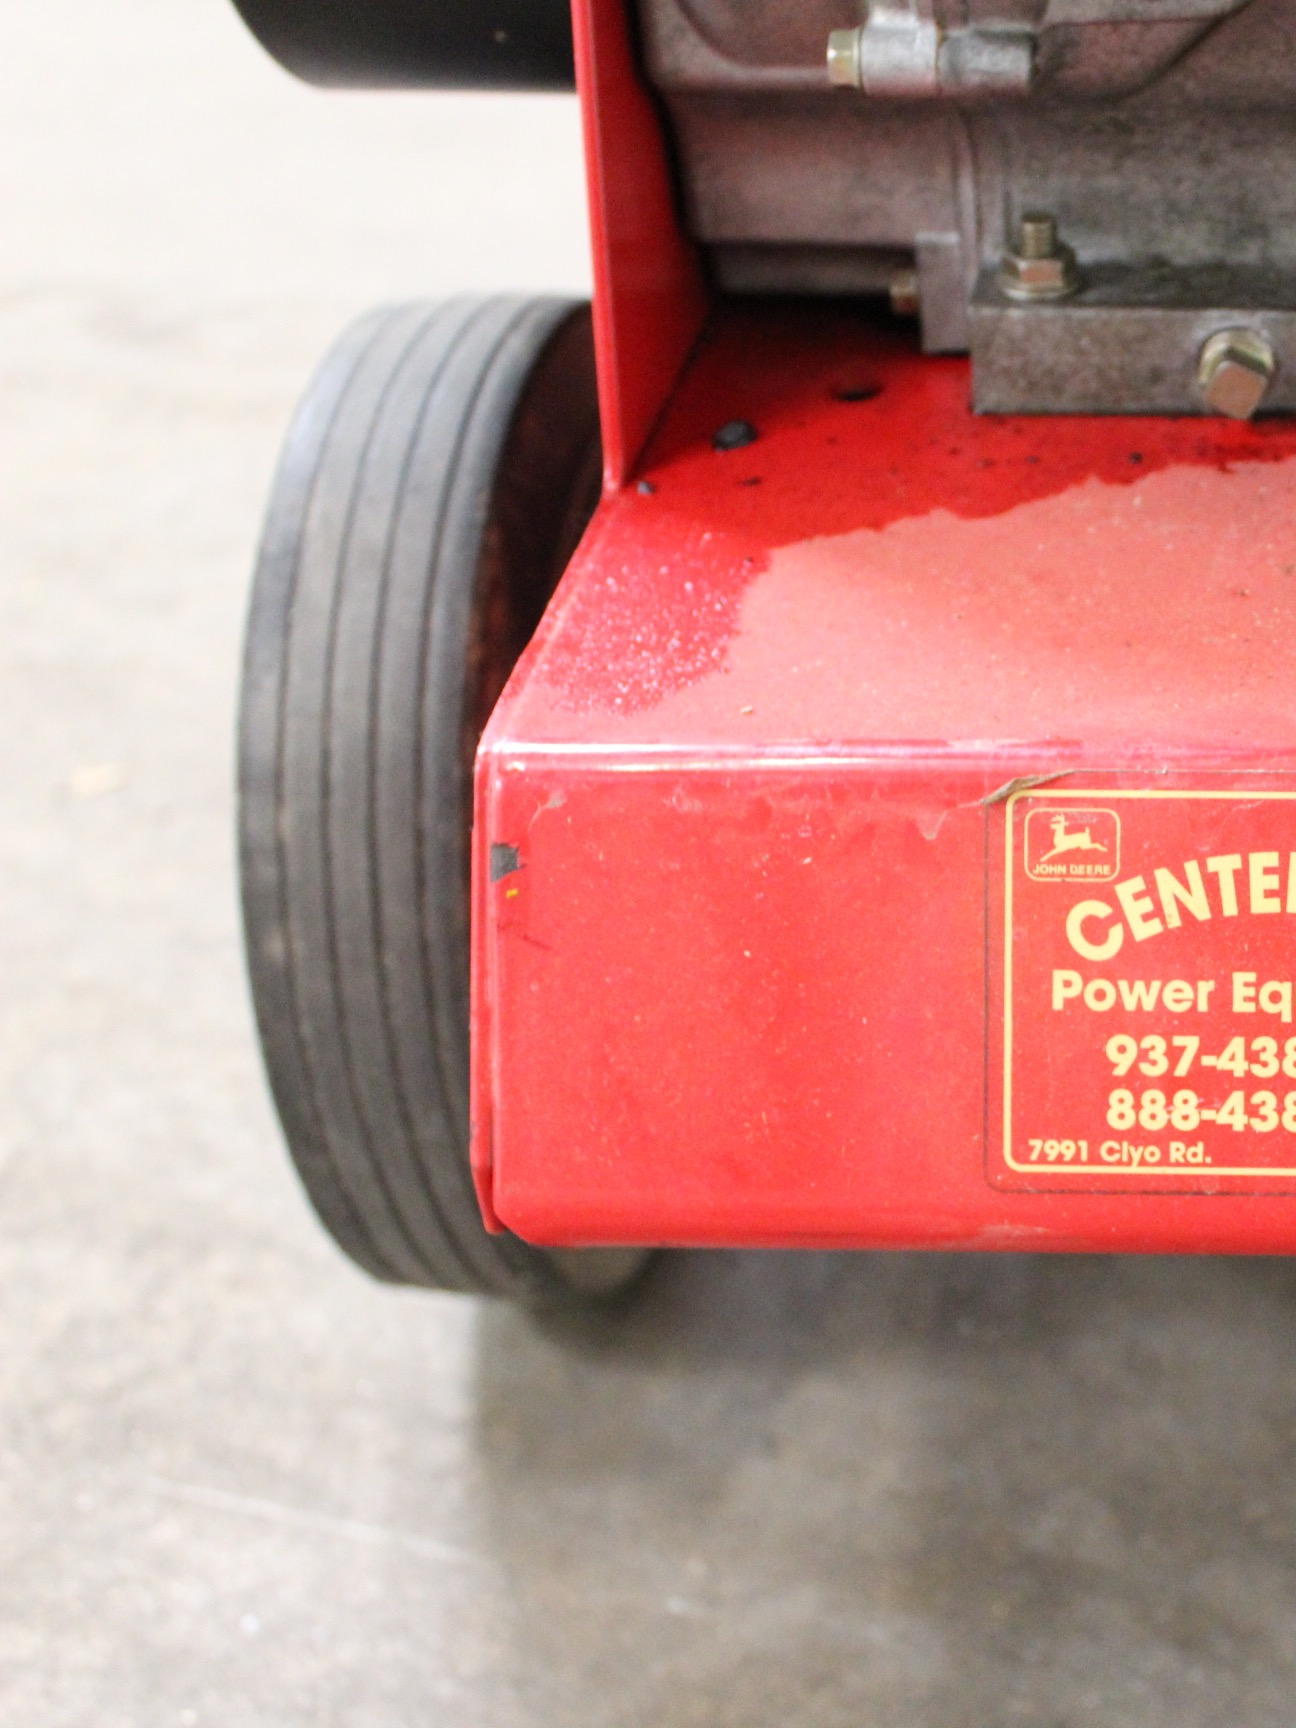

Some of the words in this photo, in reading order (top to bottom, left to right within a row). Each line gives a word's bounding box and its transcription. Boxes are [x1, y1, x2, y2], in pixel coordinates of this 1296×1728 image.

[1033, 864, 1066, 875] JOHN
[1070, 864, 1111, 875] DEERE
[1052, 969, 1215, 1013] Power
[1029, 1139, 1089, 1162] 7991
[1100, 1140, 1161, 1167] Clyo
[1170, 1141, 1211, 1163] Rd.
